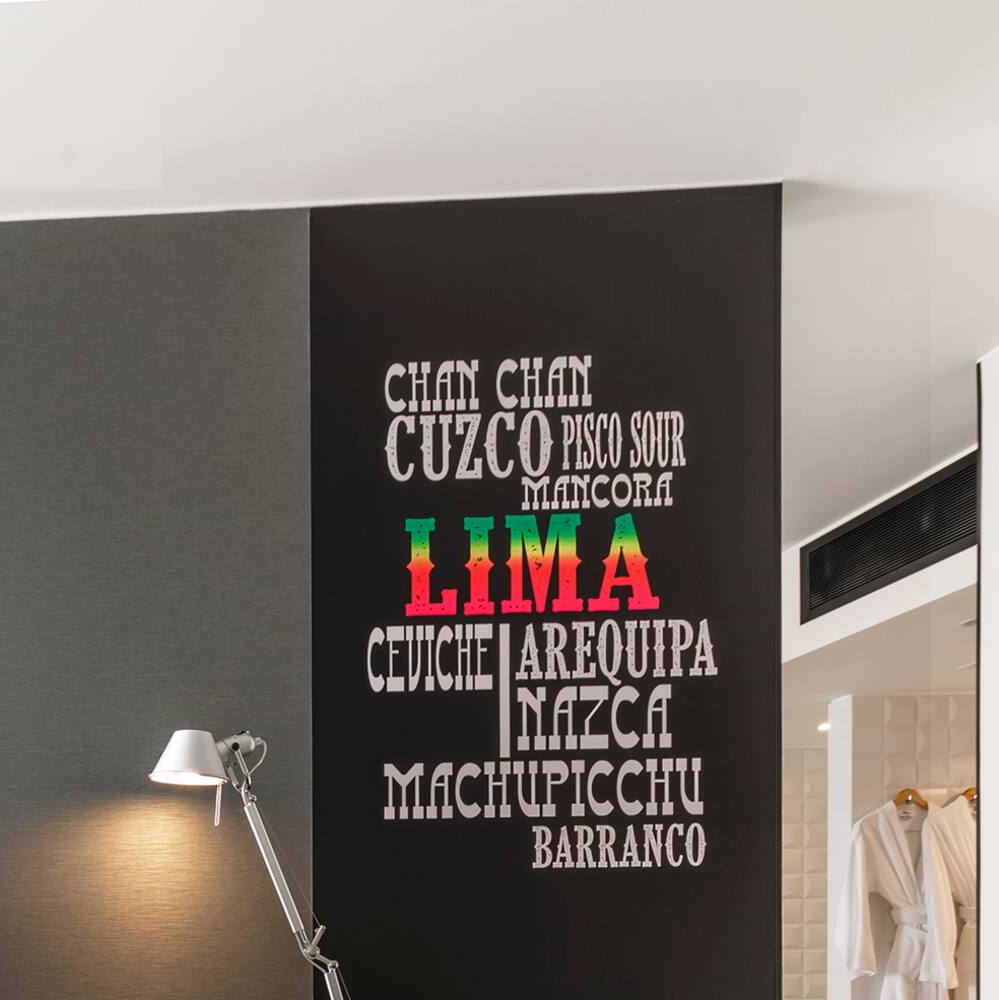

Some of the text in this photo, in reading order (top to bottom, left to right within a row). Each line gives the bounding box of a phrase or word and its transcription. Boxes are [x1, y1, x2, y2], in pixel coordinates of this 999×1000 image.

[384, 354, 593, 413] CHAN CHAN
[383, 409, 555, 482] CUZCO
[560, 410, 687, 471] PISCO SOUR
[521, 471, 674, 511] MANCORA
[404, 512, 661, 617] LIMA
[366, 622, 494, 693] CEVICHE
[514, 618, 719, 686] AREQUIPA
[516, 683, 673, 751] NAZCA
[383, 757, 704, 820] MACHUPICCHU
[531, 822, 708, 869] BARRANCO
